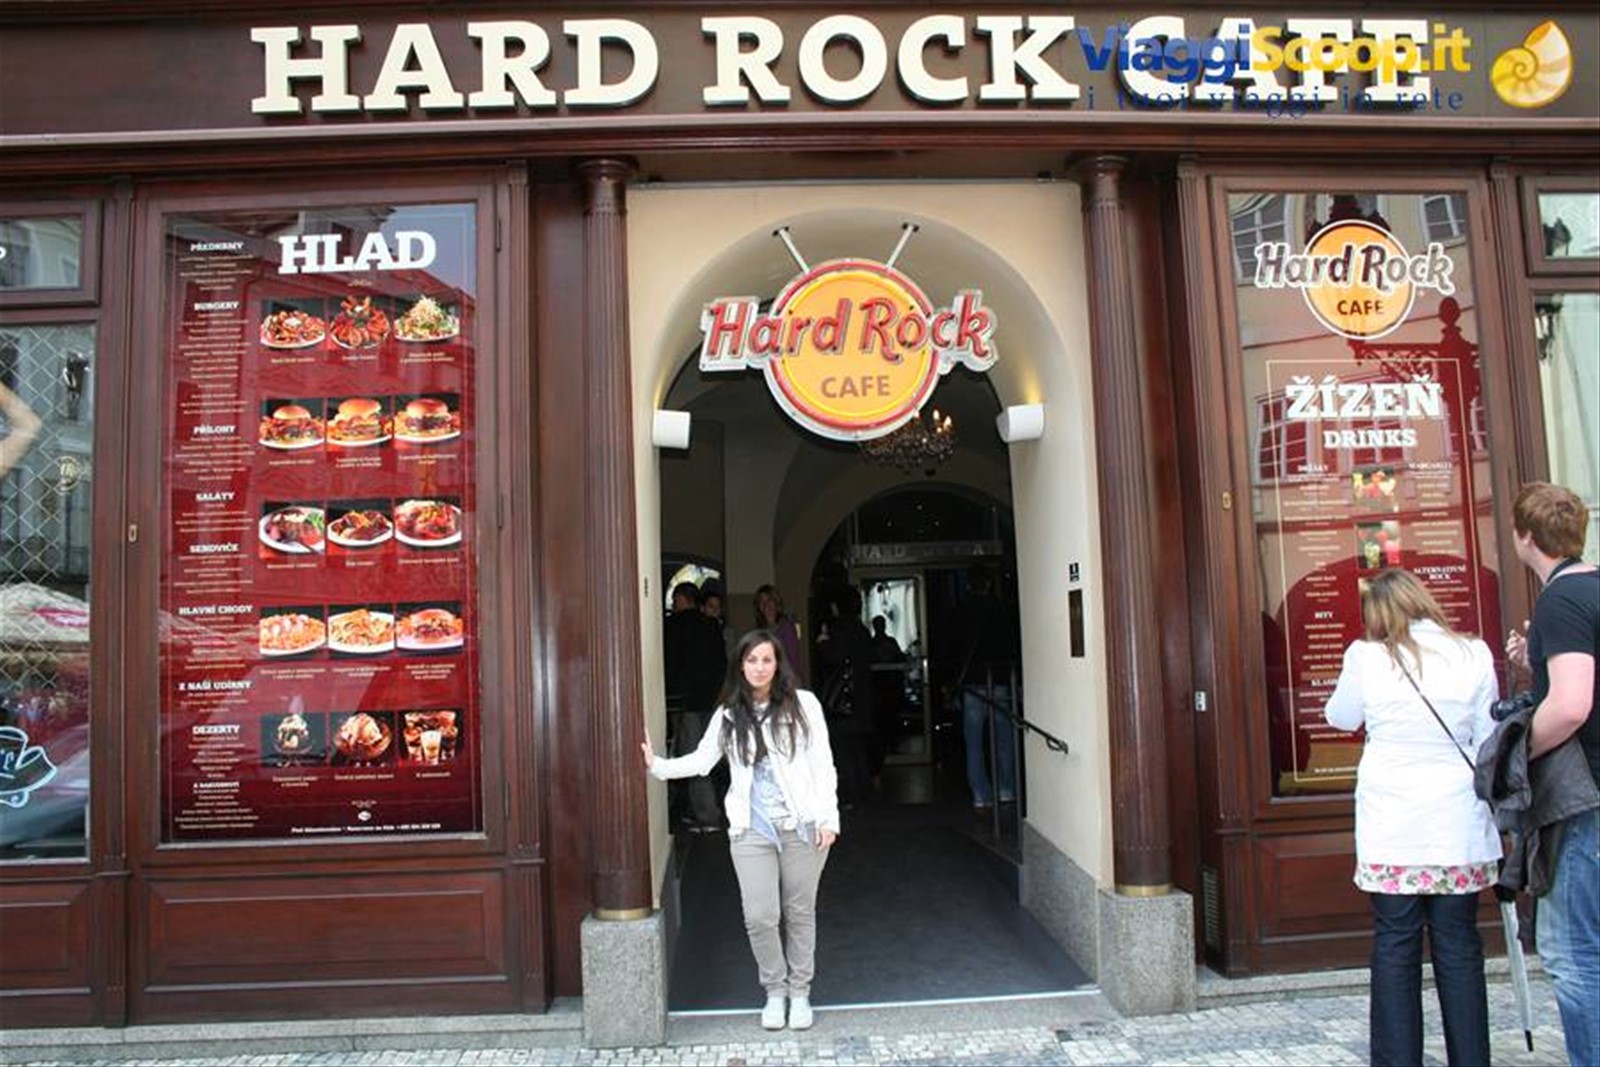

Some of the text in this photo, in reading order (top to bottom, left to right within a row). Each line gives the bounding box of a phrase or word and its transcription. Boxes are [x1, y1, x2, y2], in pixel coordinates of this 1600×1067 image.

[251, 14, 1432, 113] HARD ROCK CAFE
[278, 230, 437, 275] HLAD
[1255, 243, 1455, 295] Hard Rock
[706, 289, 990, 364] Hard Rock
[1336, 299, 1384, 316] CAFE
[820, 375, 892, 399] CAFE
[1285, 374, 1444, 419] ŽÍZEŇ
[1323, 430, 1418, 449] DRINKS
